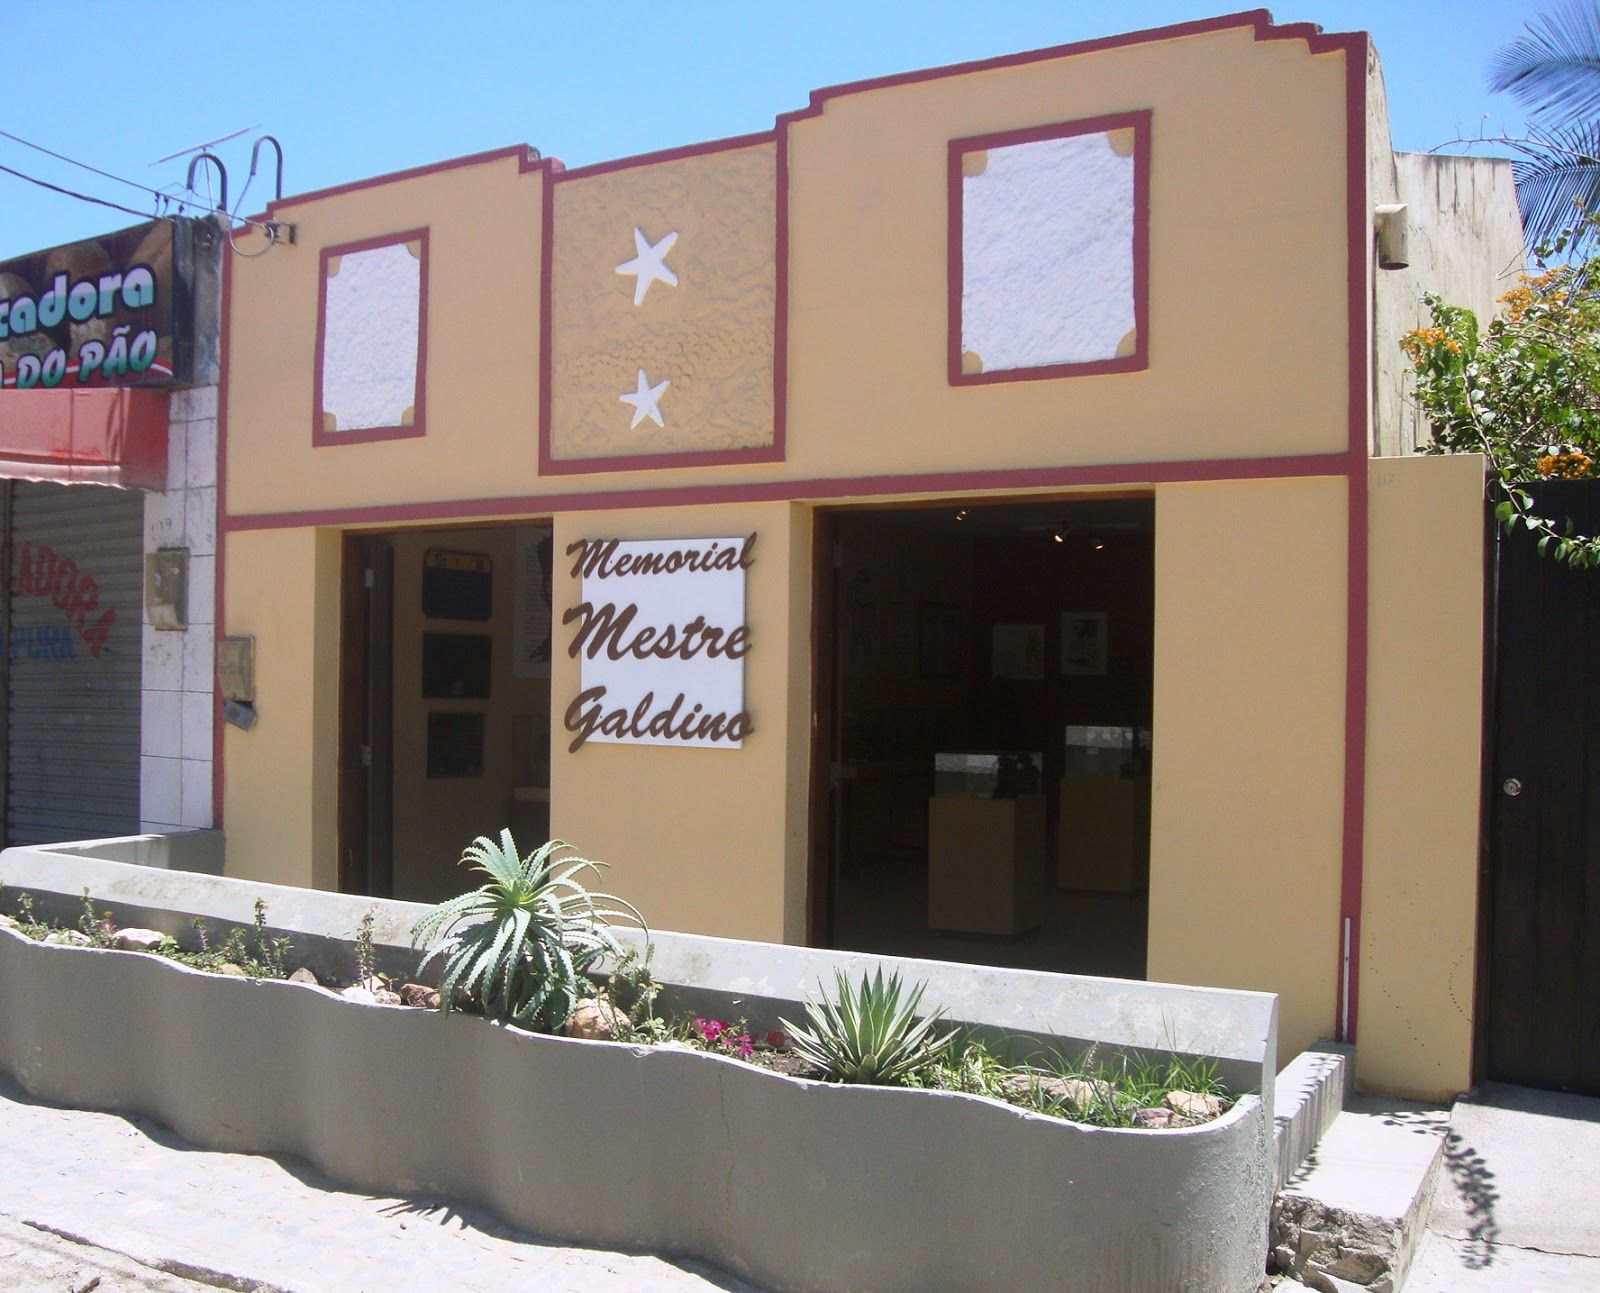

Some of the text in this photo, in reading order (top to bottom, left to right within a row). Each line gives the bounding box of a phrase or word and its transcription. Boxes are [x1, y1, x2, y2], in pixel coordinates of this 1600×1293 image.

[16, 348, 66, 389] DO
[79, 325, 157, 382] PÃO
[566, 531, 758, 579] Memorial
[562, 601, 753, 662] Mestre
[564, 685, 755, 754] Galdino
